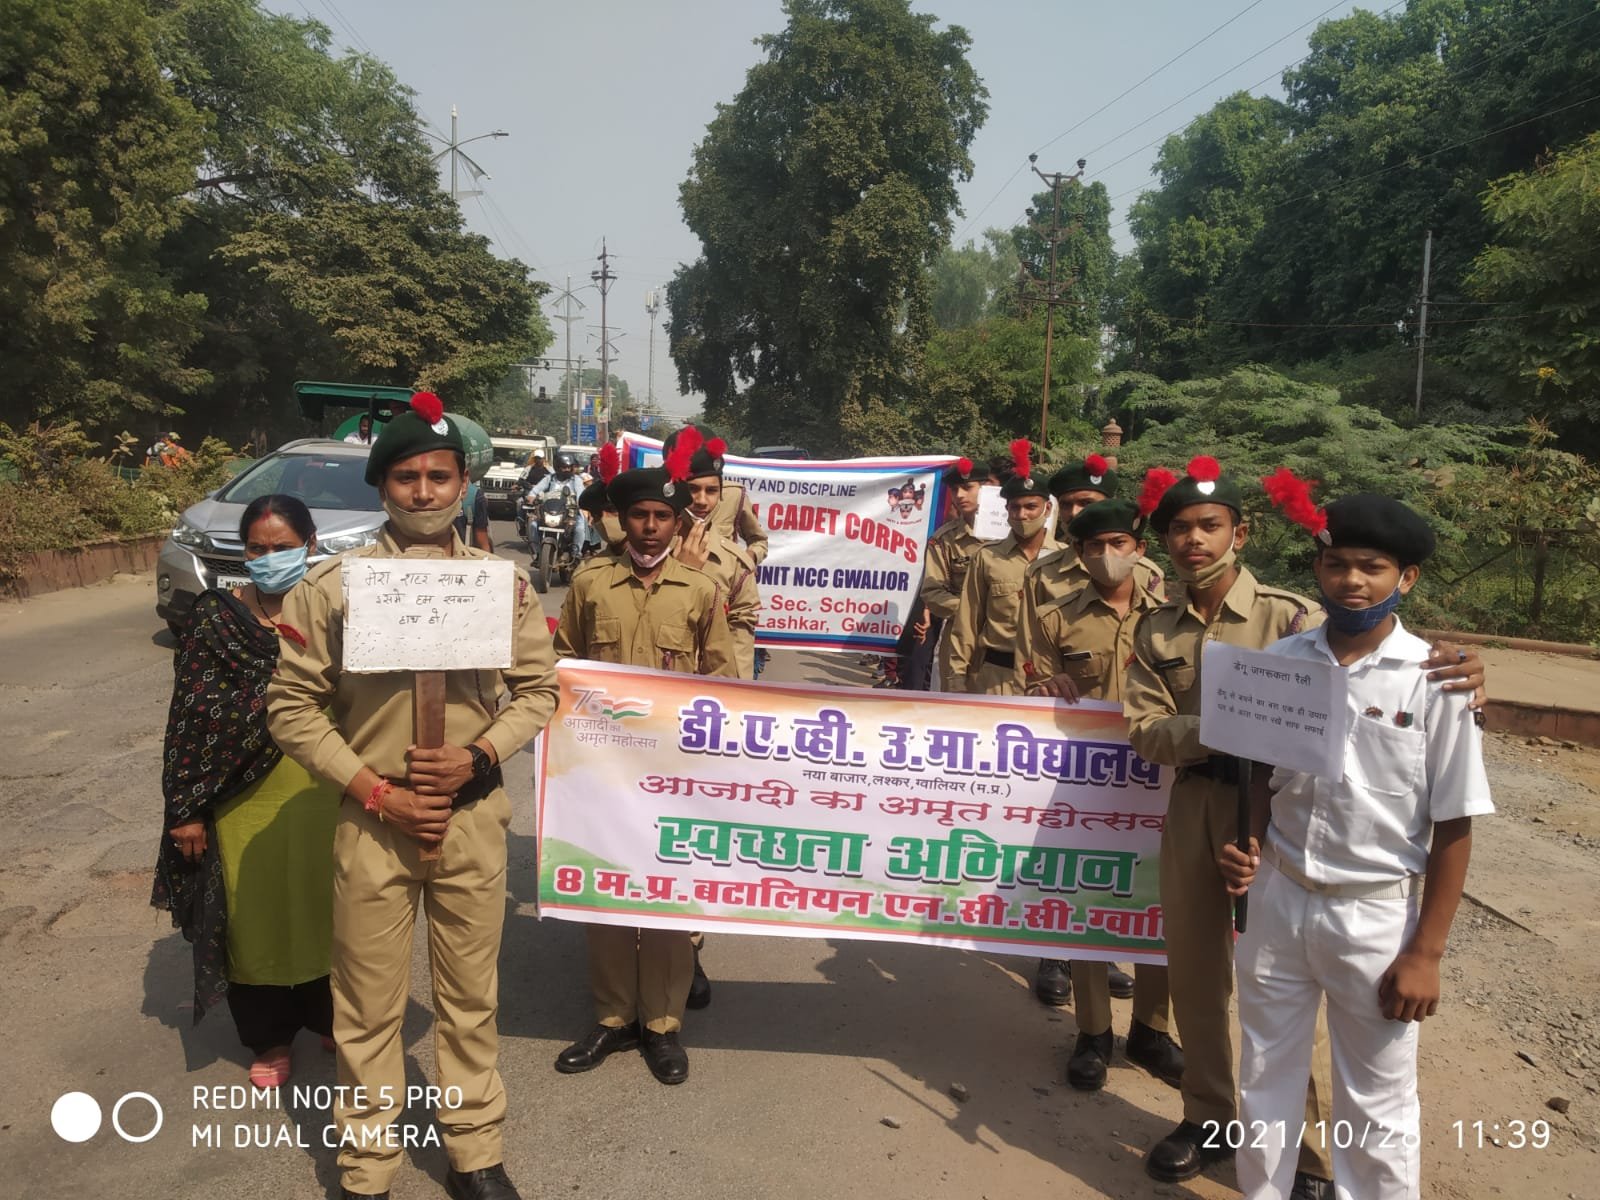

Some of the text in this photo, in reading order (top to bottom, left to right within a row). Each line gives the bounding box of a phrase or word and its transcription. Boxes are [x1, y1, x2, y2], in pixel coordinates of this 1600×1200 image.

[758, 479, 786, 494] AND
[788, 482, 857, 497] DISCIPLINE
[767, 503, 840, 536] CADET
[845, 512, 919, 564] CORPS
[364, 564, 391, 587] मेरा
[793, 567, 829, 588] NCC
[832, 569, 910, 592] GWALIOR
[770, 594, 889, 616] Sec. School
[755, 614, 830, 633] Lashkar,
[1295, 672, 1312, 687] रैली
[576, 731, 658, 749] अमृत महोत्सव
[681, 697, 866, 764] डी.ए.व्ही.
[803, 769, 826, 781] नया
[970, 781, 1012, 799] (म.प्र.)
[638, 775, 1167, 833] आजादी का अमृत महोत्सव
[656, 816, 1139, 895] स्वच्छता अभियान
[555, 866, 583, 893] 8
